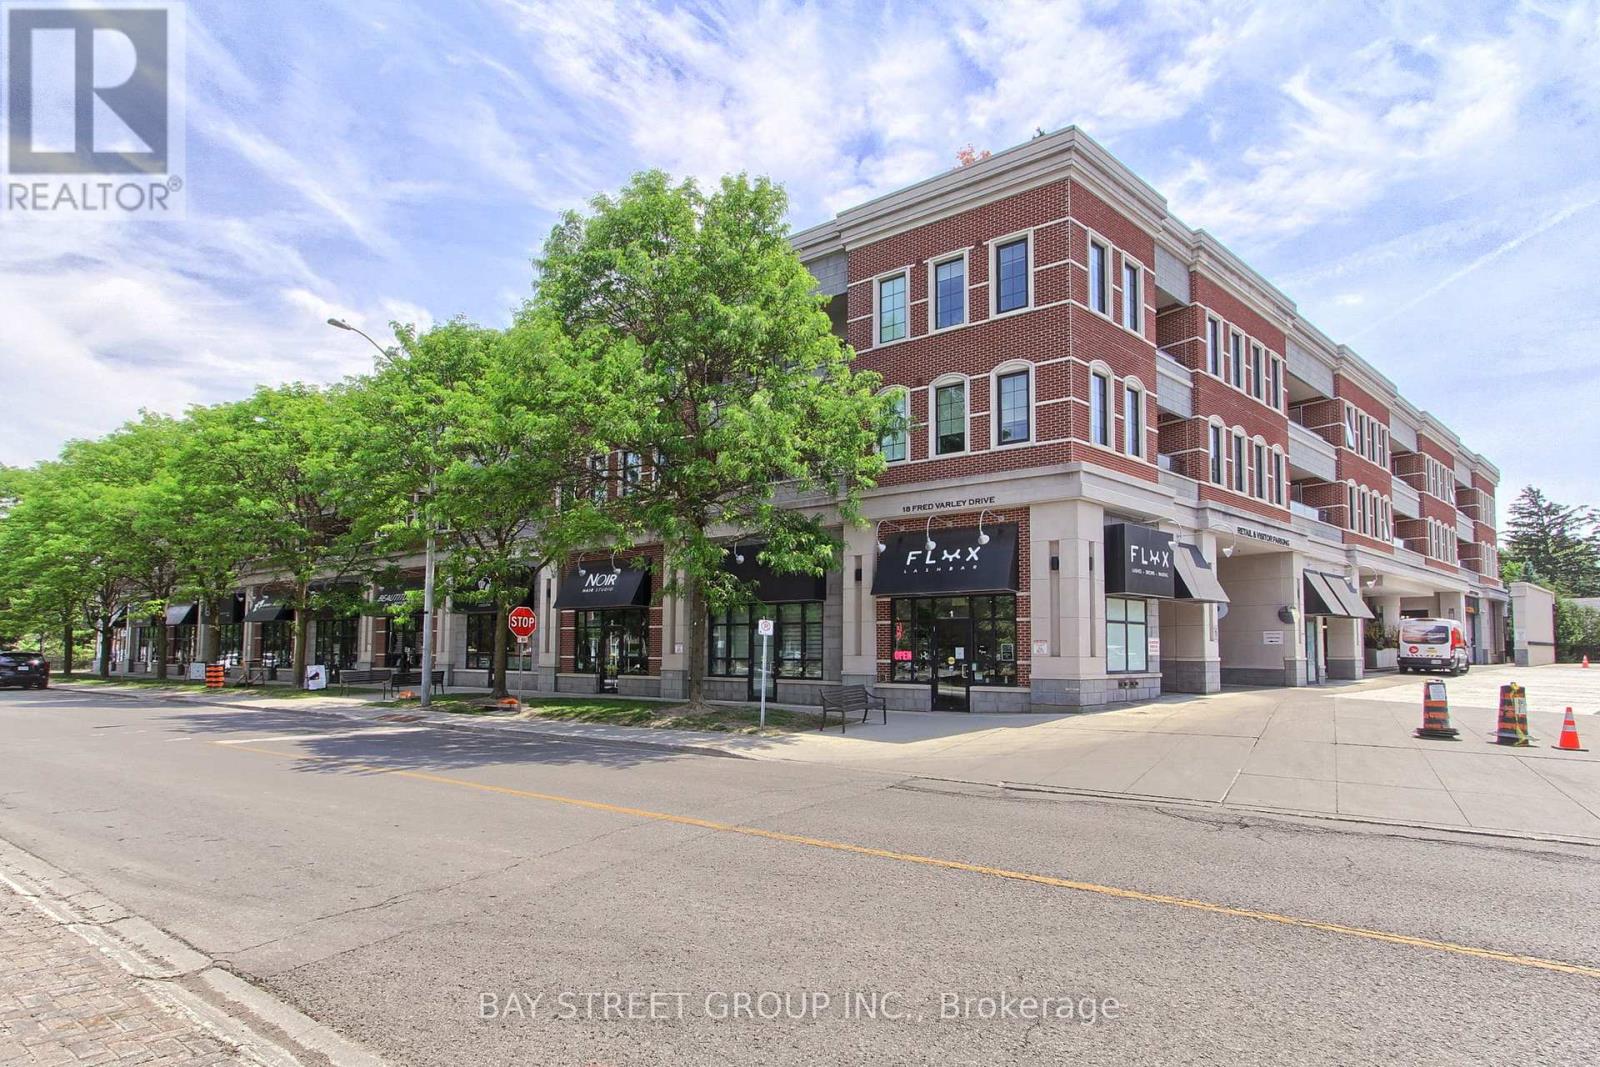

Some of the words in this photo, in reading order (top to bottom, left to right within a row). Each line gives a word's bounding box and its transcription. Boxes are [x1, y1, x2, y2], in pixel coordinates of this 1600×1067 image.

[912, 503, 934, 512] FRED
[935, 499, 967, 509] VARLEY
[968, 496, 995, 506] DRIVE
[1237, 526, 1253, 538] RETAIL
[1257, 531, 1273, 542] VISITOR
[585, 573, 618, 587] NOIR
[511, 616, 535, 628] STOP
